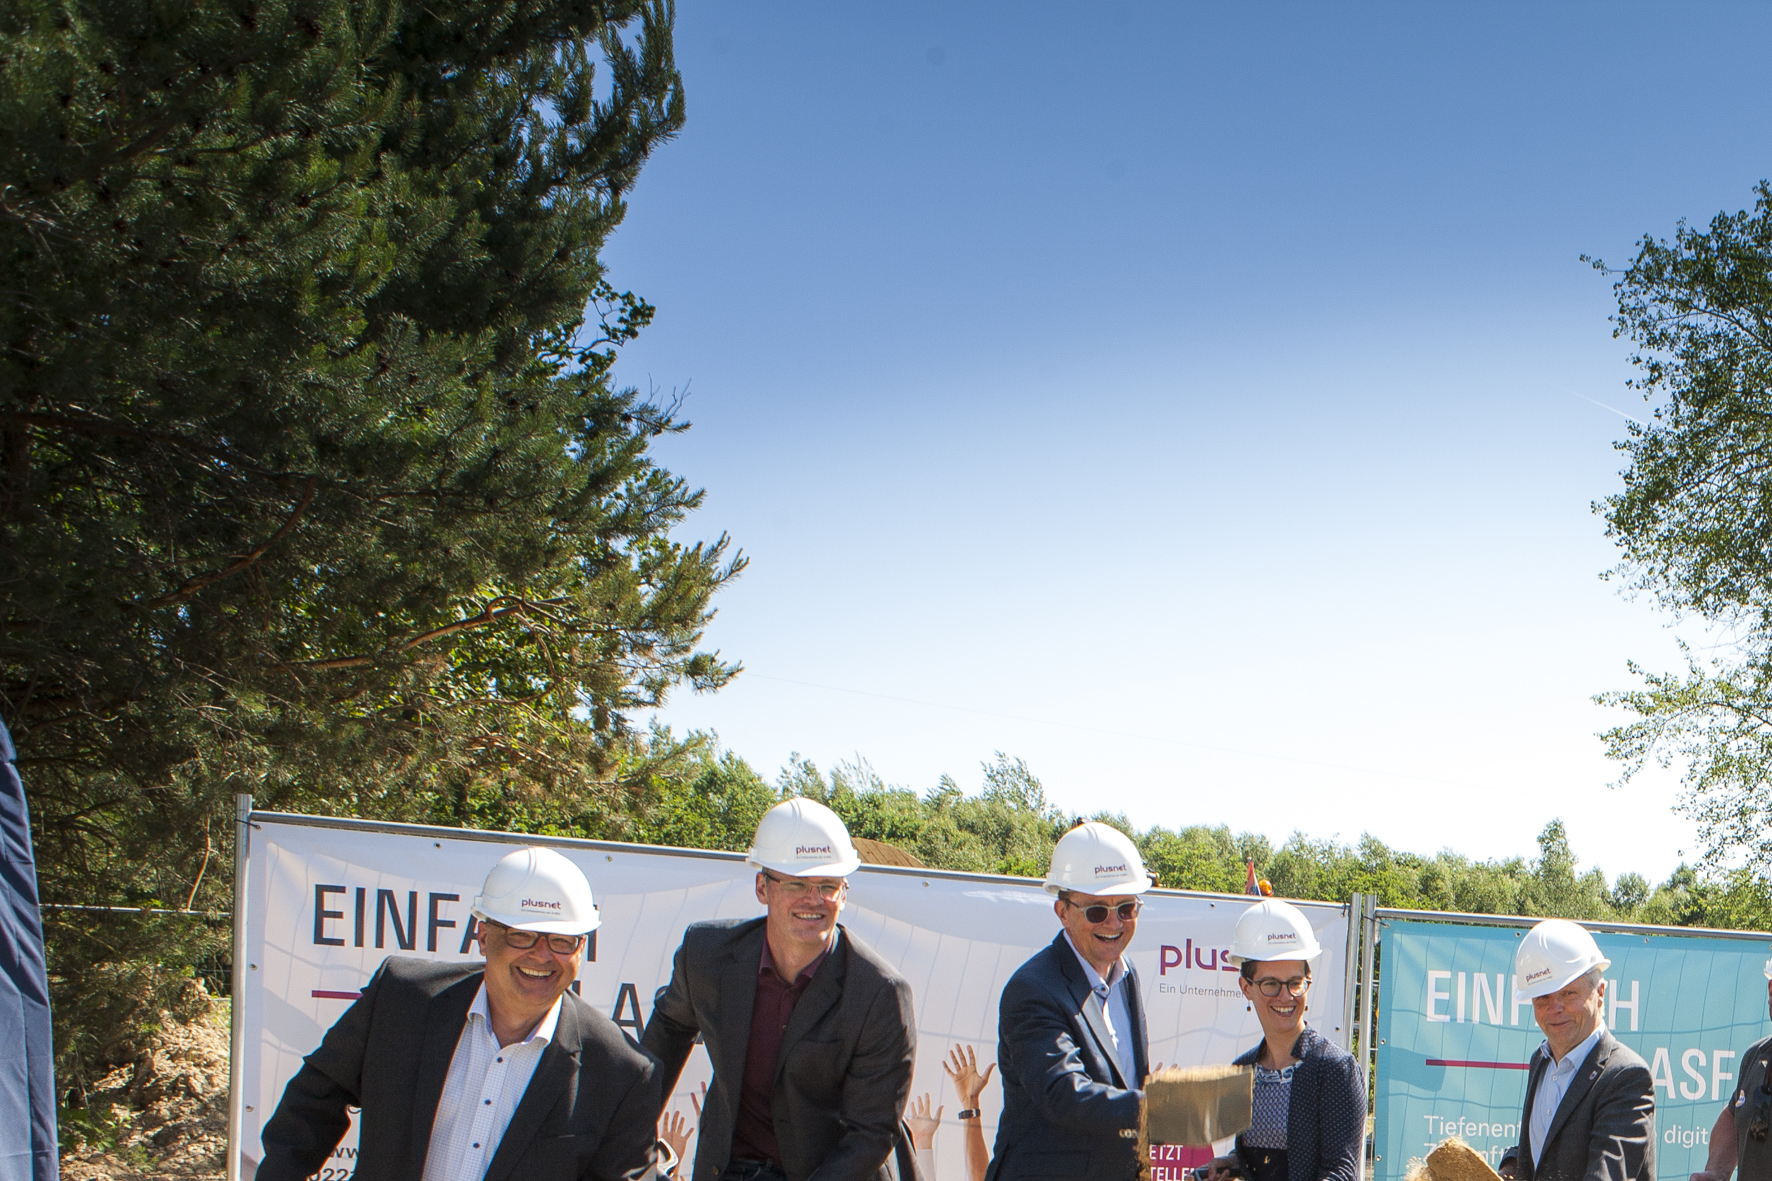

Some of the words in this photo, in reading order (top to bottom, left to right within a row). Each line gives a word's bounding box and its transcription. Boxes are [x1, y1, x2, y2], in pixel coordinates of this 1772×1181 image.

[795, 844, 832, 856] plusnet
[1094, 863, 1128, 875] plusnet
[521, 898, 562, 910] plusnet
[313, 884, 598, 962] EINF
[1267, 932, 1297, 942] plusnet
[1160, 938, 1240, 976] plus
[1159, 983, 1176, 994] Ein
[1426, 970, 1640, 1032] EINFH
[1423, 1115, 1522, 1138] Tiefenent
[1664, 1124, 1709, 1149] digit
[1149, 1144, 1184, 1161] ETZT
